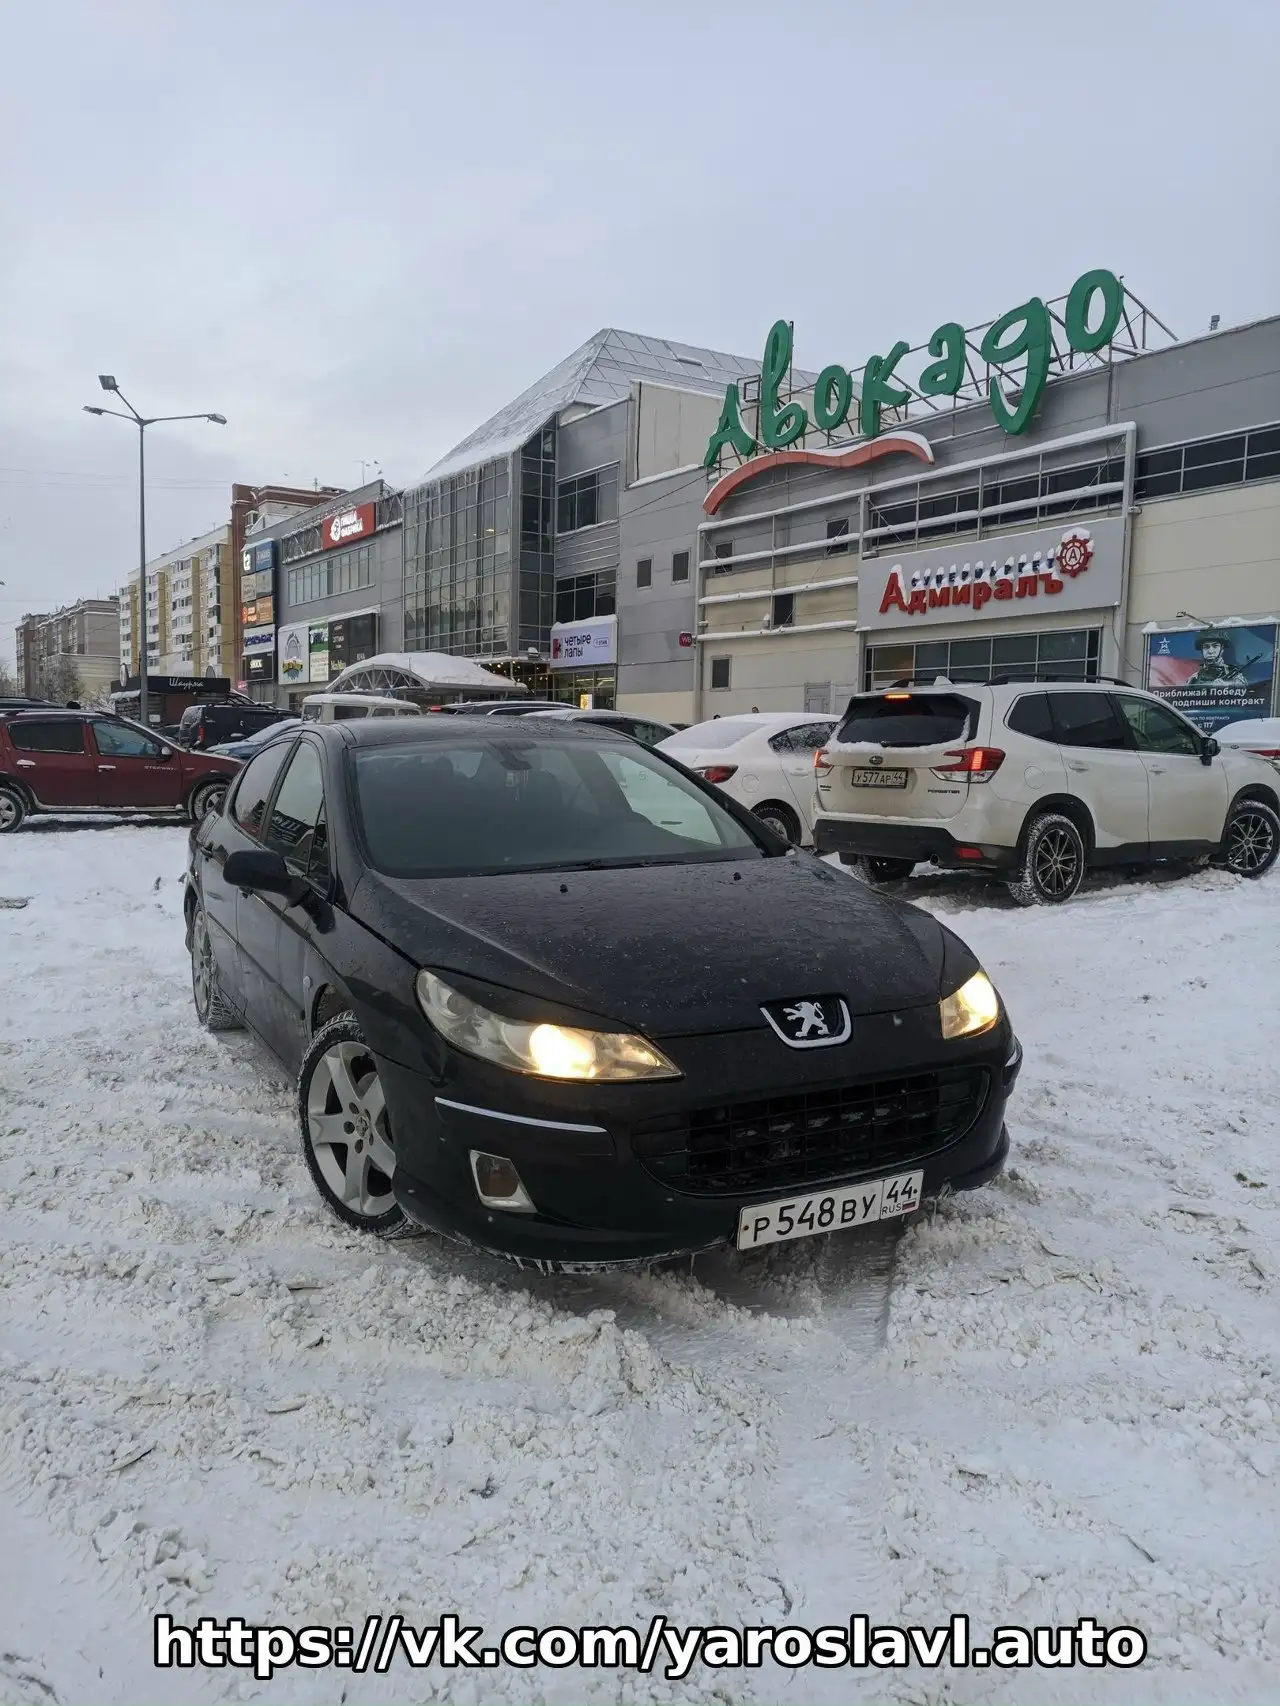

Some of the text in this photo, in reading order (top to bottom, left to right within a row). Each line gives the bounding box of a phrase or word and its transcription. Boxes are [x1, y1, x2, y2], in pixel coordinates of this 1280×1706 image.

[704, 269, 1124, 467] Авокадо
[879, 568, 1064, 615] Адмиралъ
[1153, 688, 1207, 698] Приближай
[1210, 687, 1247, 697] Победу
[1172, 698, 1265, 708] подпиши контракт
[886, 1177, 913, 1203] 44
[882, 1204, 902, 1216] RUS
